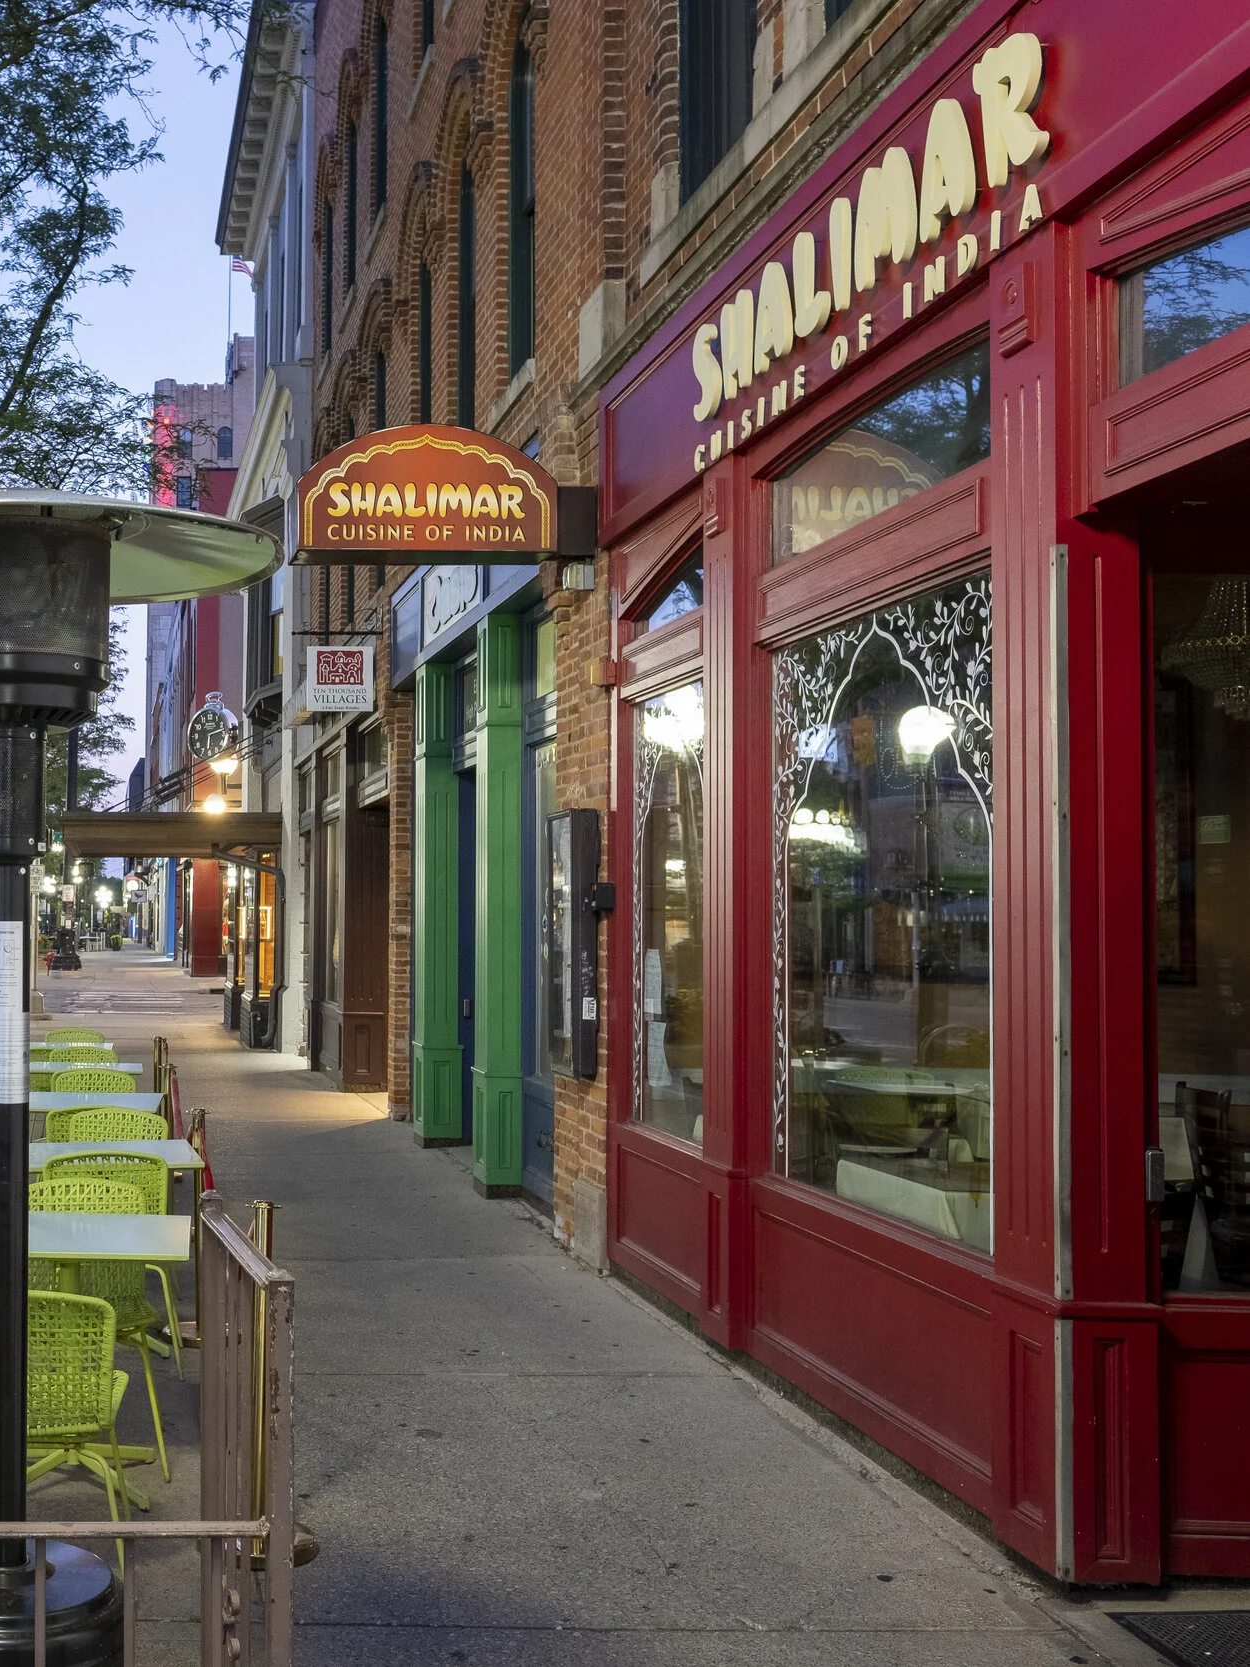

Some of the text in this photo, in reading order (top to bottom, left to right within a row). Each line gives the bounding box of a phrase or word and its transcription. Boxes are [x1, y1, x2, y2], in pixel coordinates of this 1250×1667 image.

[693, 32, 1050, 422] SHALIMAR
[694, 183, 1044, 473] CUISINE OF INDIA
[327, 482, 526, 520] SHALIMAR
[327, 523, 526, 543] CUISINE OF INDIA
[313, 694, 367, 704] VILLAGES
